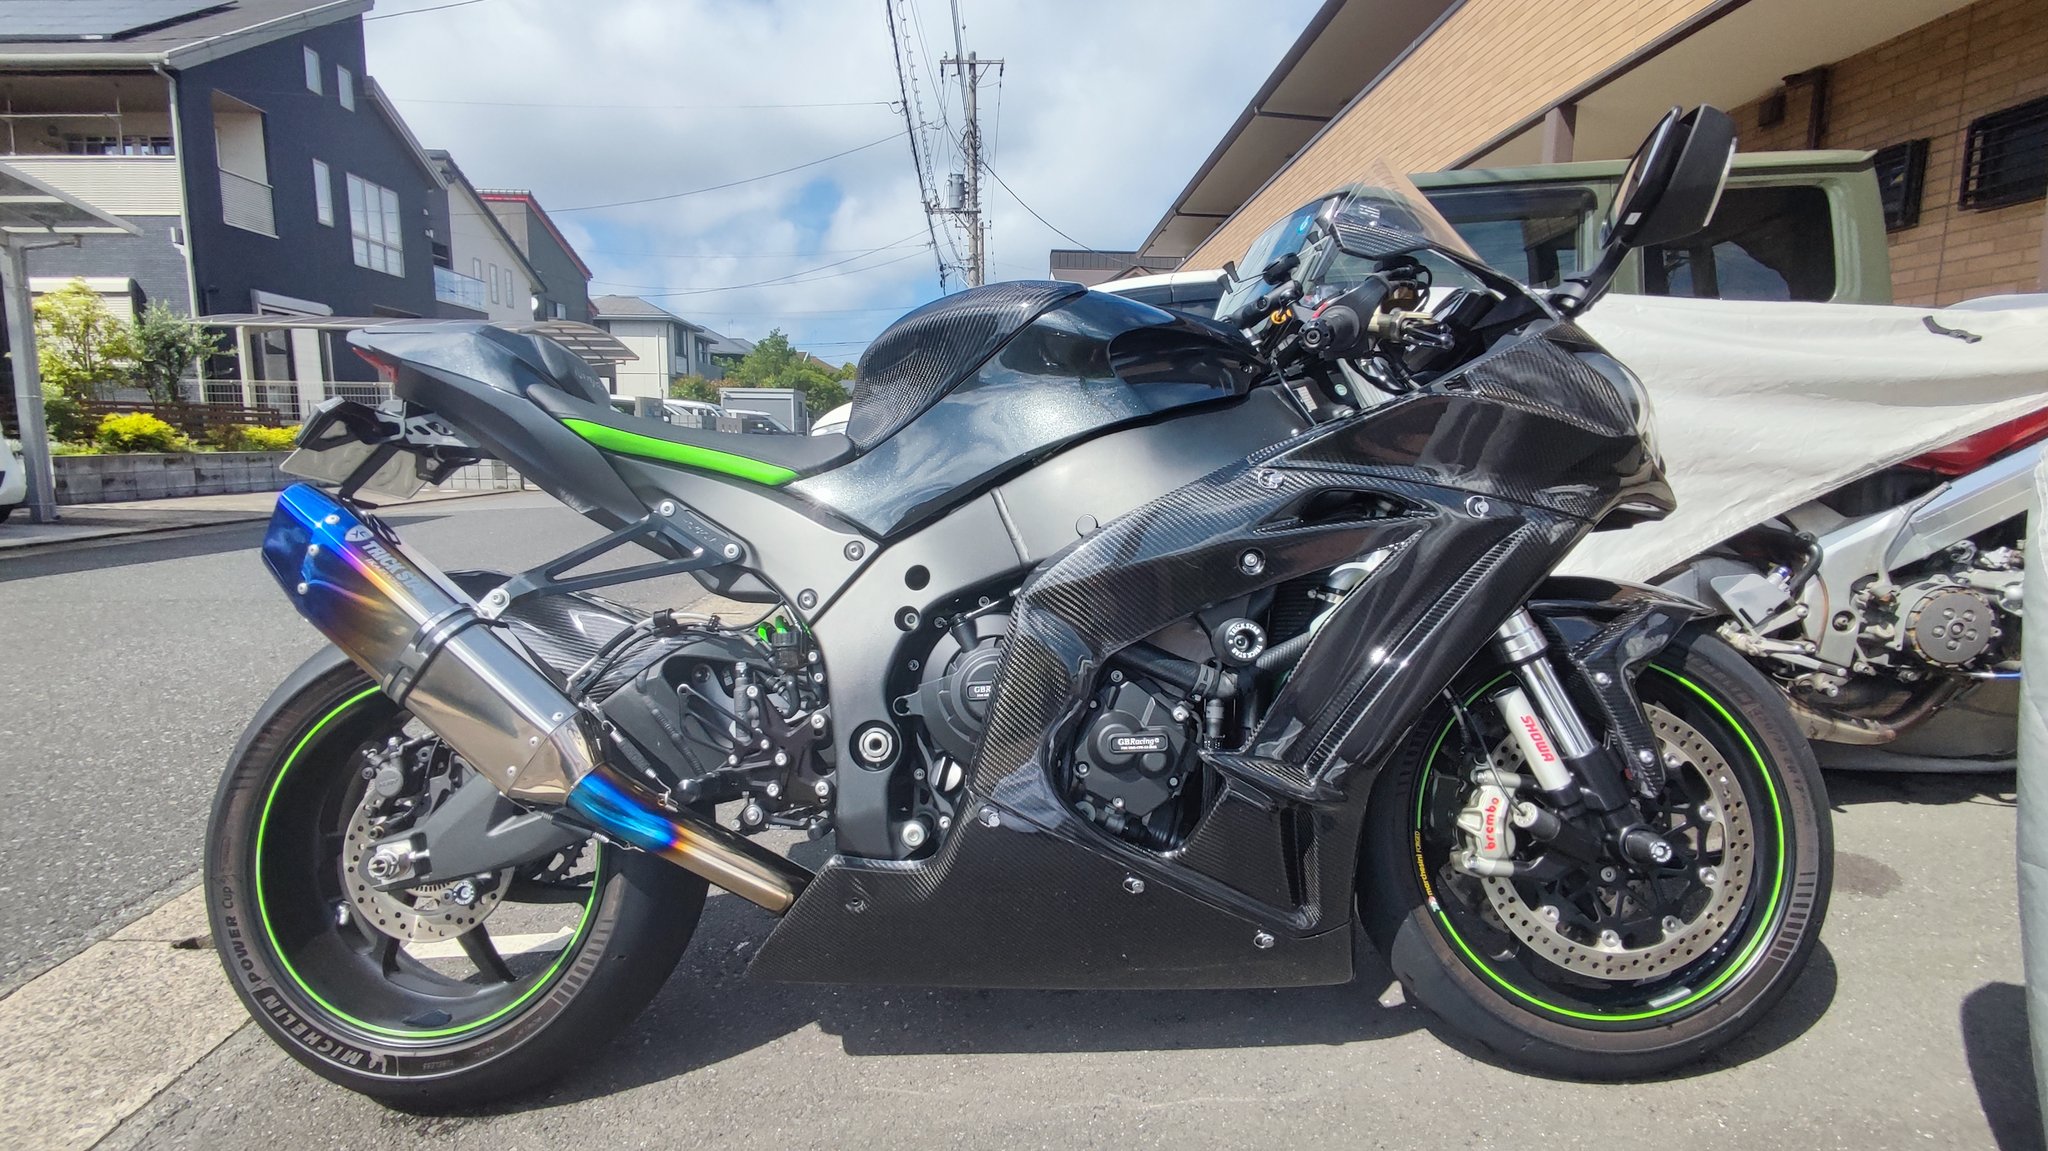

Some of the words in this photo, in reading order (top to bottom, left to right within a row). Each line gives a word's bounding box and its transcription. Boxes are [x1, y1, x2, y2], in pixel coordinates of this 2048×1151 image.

[362, 540, 407, 574] TRICK
[1230, 623, 1245, 635] TRICK
[1246, 623, 1261, 635] STAR
[1520, 714, 1555, 763] SHOWA
[1485, 797, 1500, 851] brembo
[1415, 854, 1433, 896] marchesini
[225, 915, 262, 983] POWER
[262, 994, 364, 1066] MICHELIN
